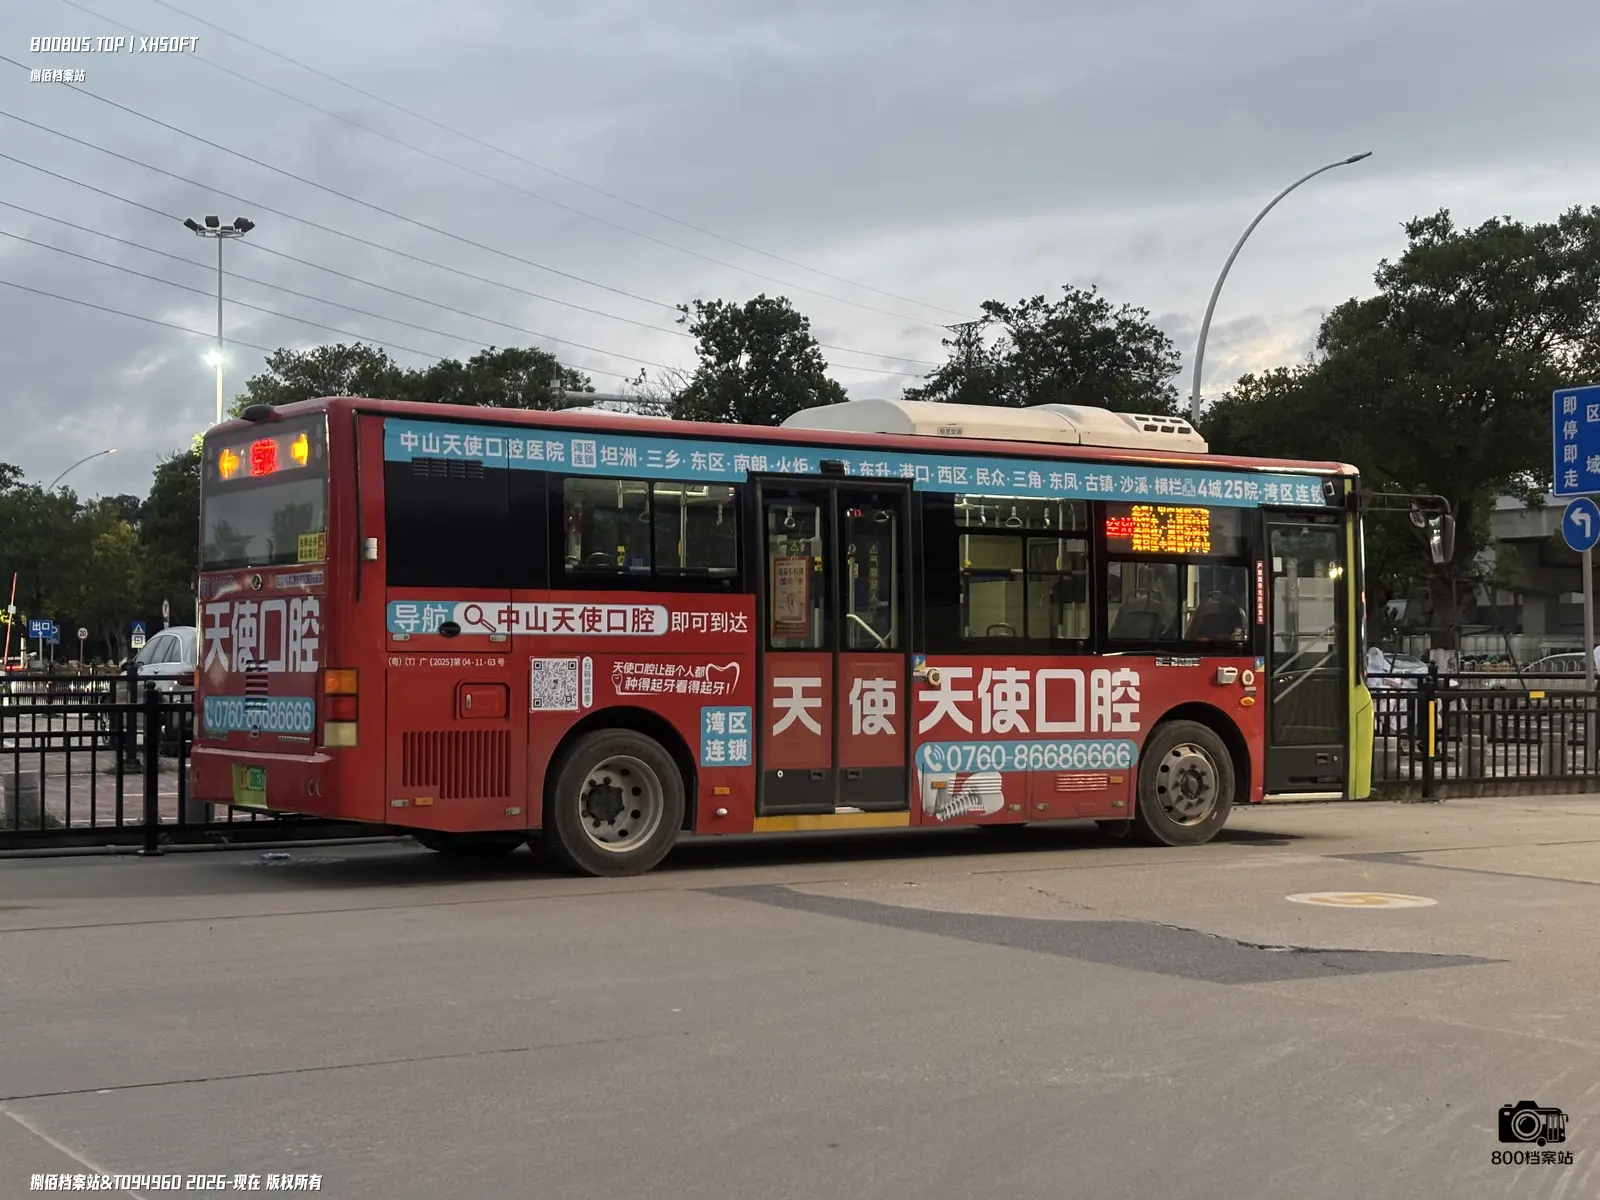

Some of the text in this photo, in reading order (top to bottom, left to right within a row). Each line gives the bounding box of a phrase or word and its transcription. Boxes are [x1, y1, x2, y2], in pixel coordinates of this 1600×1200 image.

[399, 430, 565, 463] 中山天使口腔医院
[1562, 396, 1579, 488] 即停即走
[32, 621, 50, 631] 出口
[394, 603, 748, 634] 导航 中山天使口腔 即可到达
[203, 595, 320, 673] 天使口腔
[612, 661, 706, 679] 天使口腔让每个人都
[918, 666, 1141, 735] 天使口腔
[705, 711, 748, 735] 湾区
[705, 739, 748, 762] 连锁
[946, 743, 1131, 770] 0760-86686666
